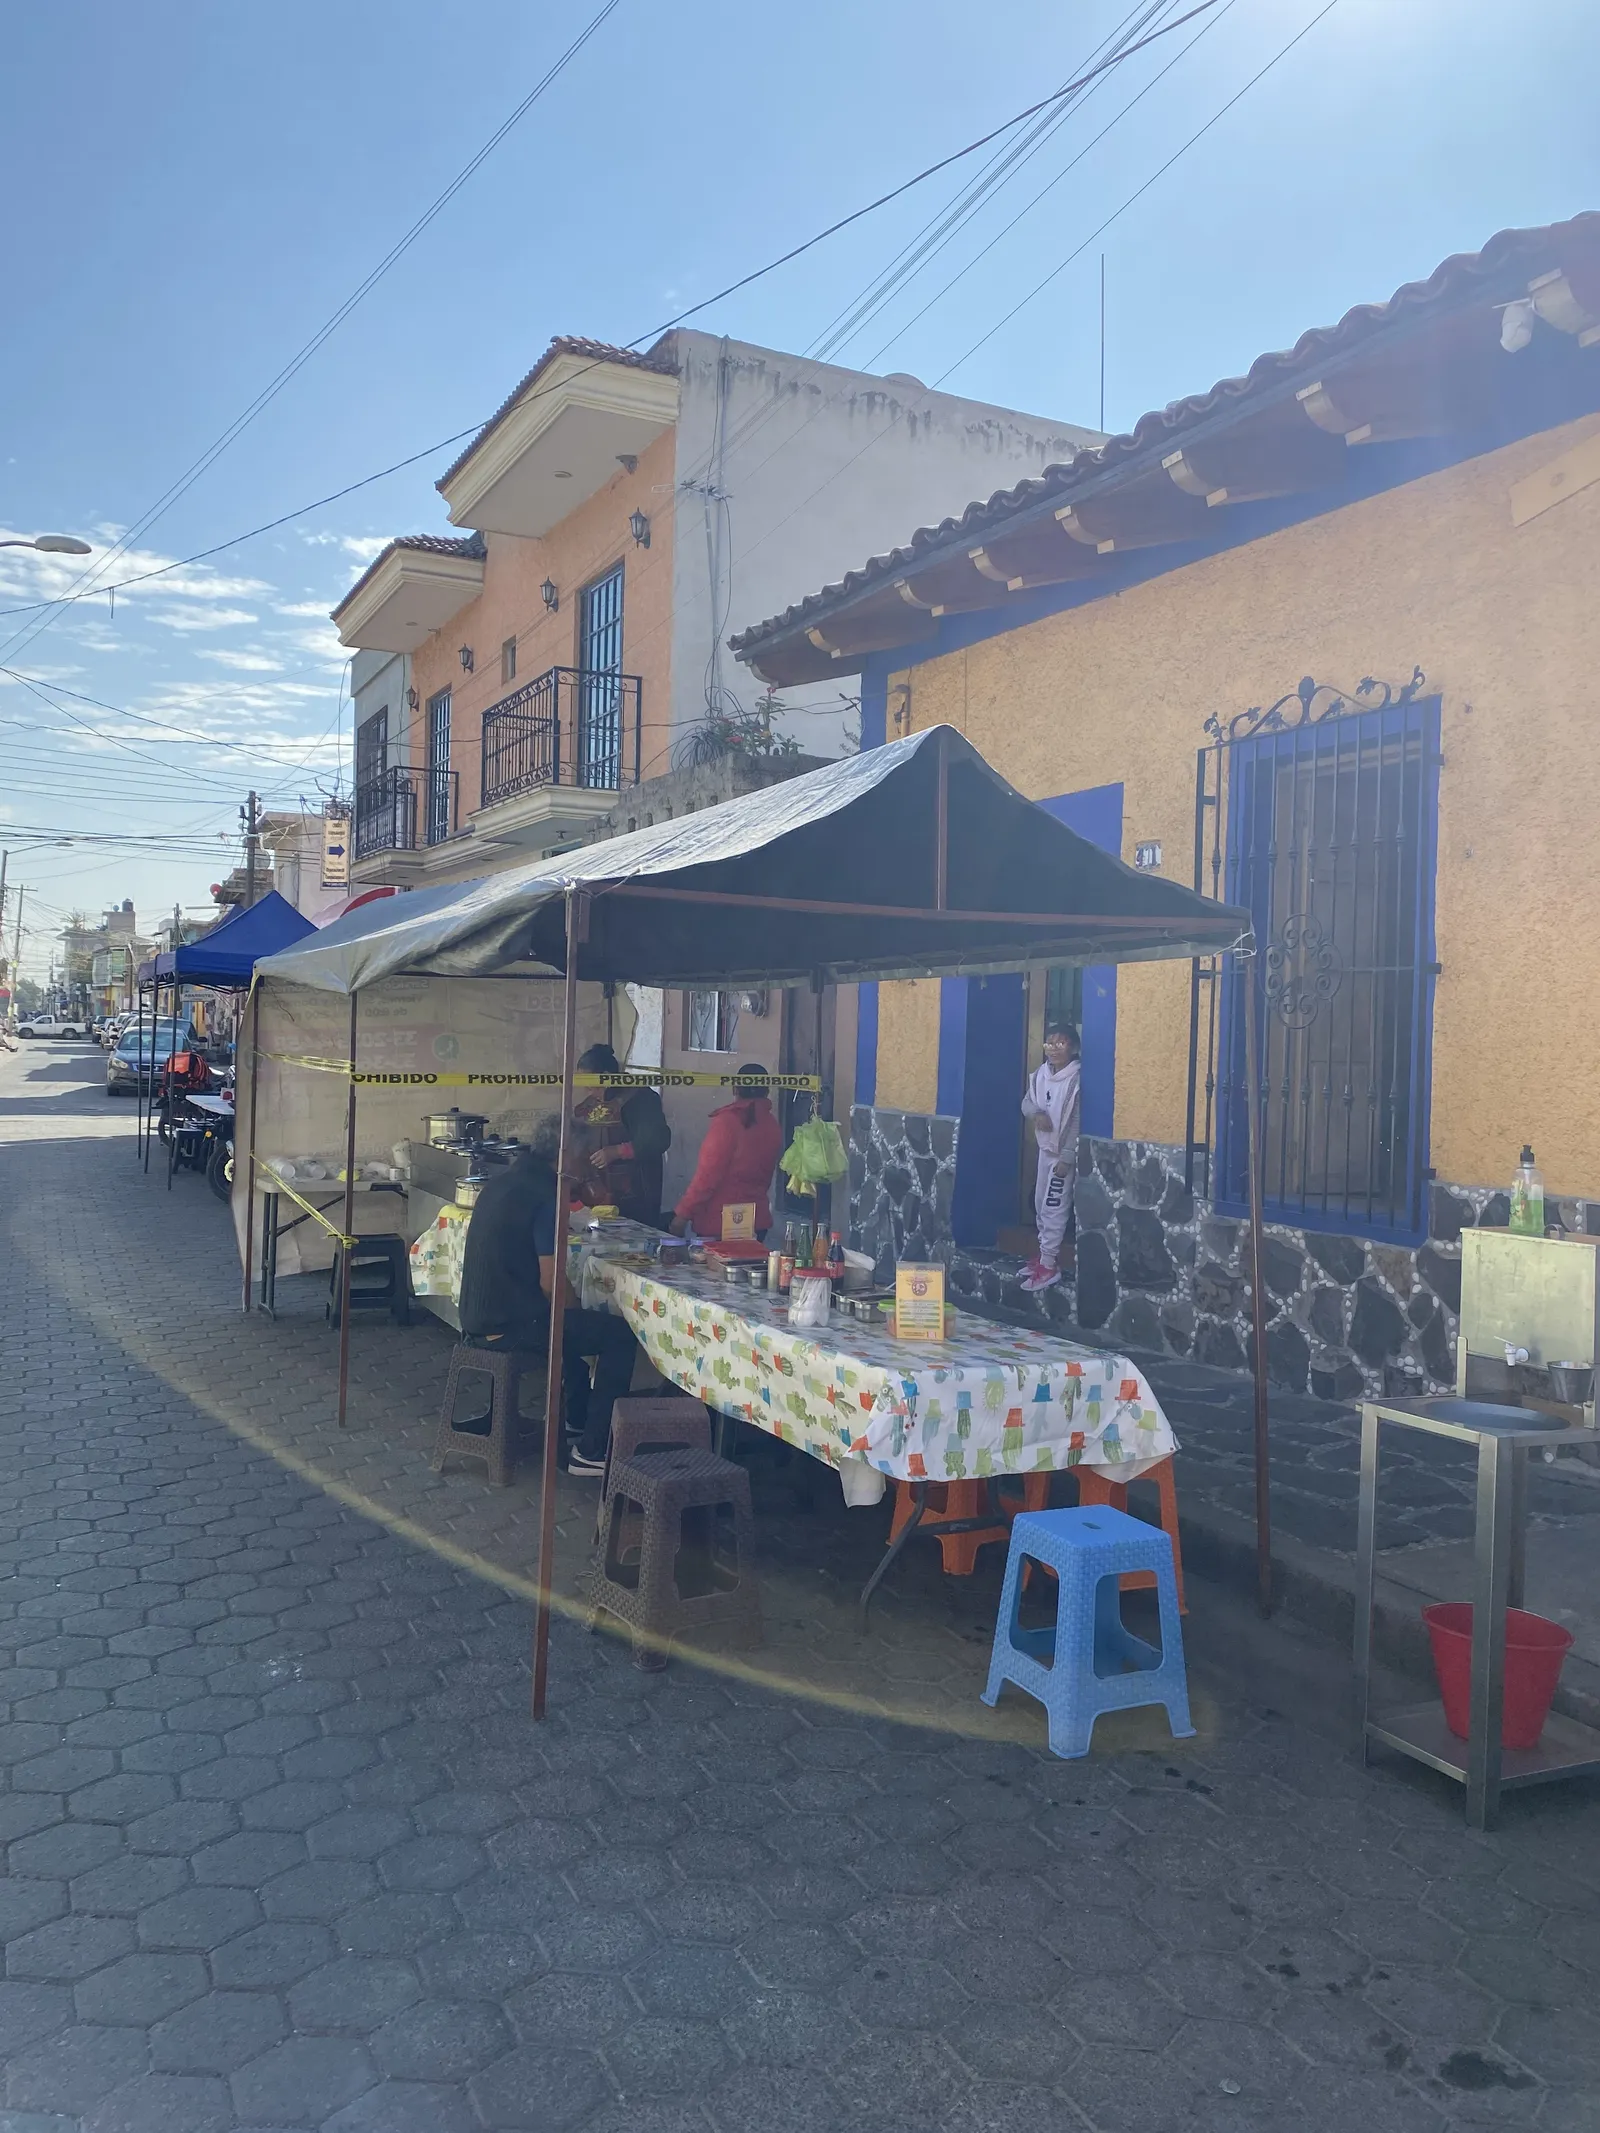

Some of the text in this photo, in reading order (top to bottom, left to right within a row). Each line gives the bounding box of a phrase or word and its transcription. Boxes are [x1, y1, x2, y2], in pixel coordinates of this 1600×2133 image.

[599, 1074, 695, 1086] PROHIBIDO
[720, 1075, 811, 1087] PROHIBIDO
[1046, 1168, 1065, 1207] OLO
